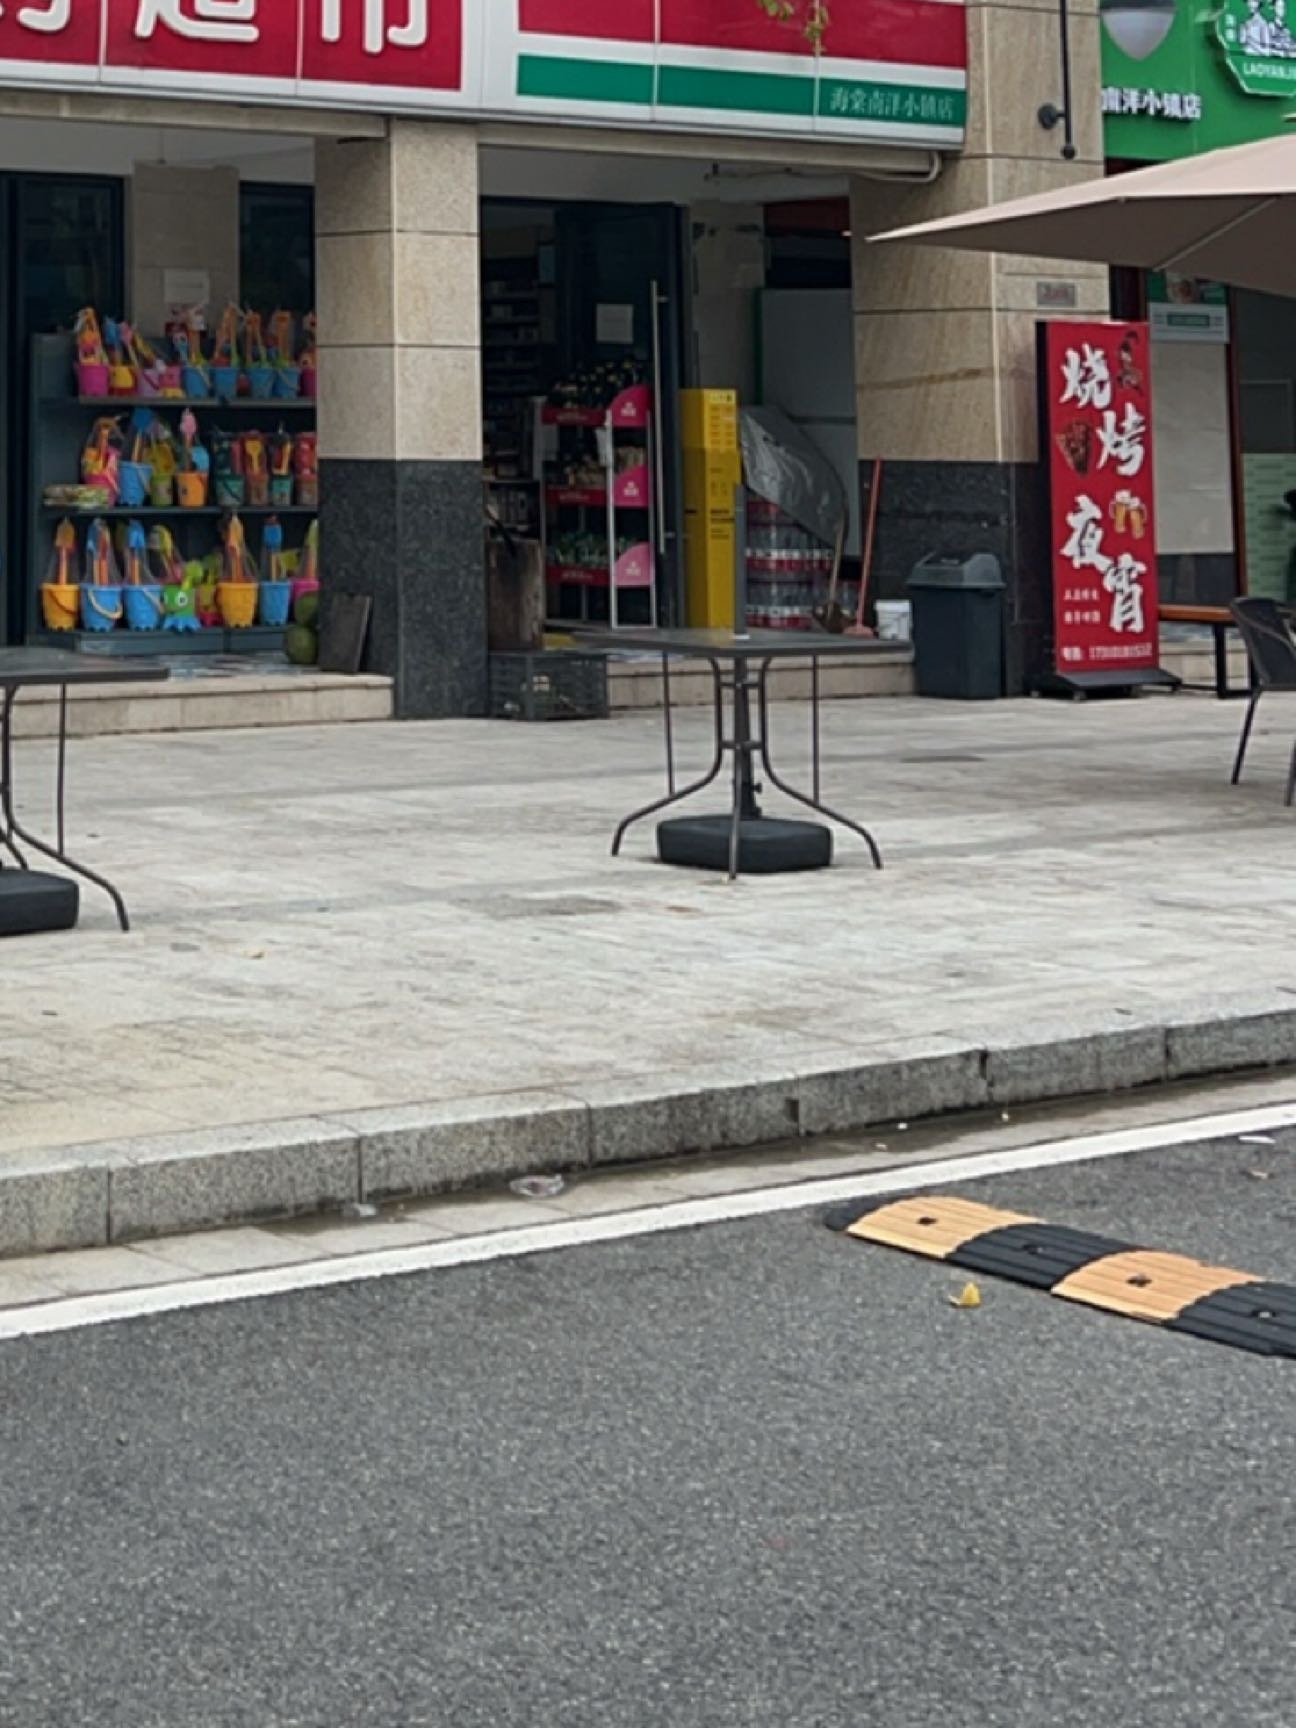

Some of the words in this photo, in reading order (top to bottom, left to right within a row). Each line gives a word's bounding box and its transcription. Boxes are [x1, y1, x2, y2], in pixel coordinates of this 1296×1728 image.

[829, 86, 955, 121] 海棠南洋小镇店
[1059, 341, 1146, 477] 烧烤
[1060, 494, 1147, 633] 夜宵
